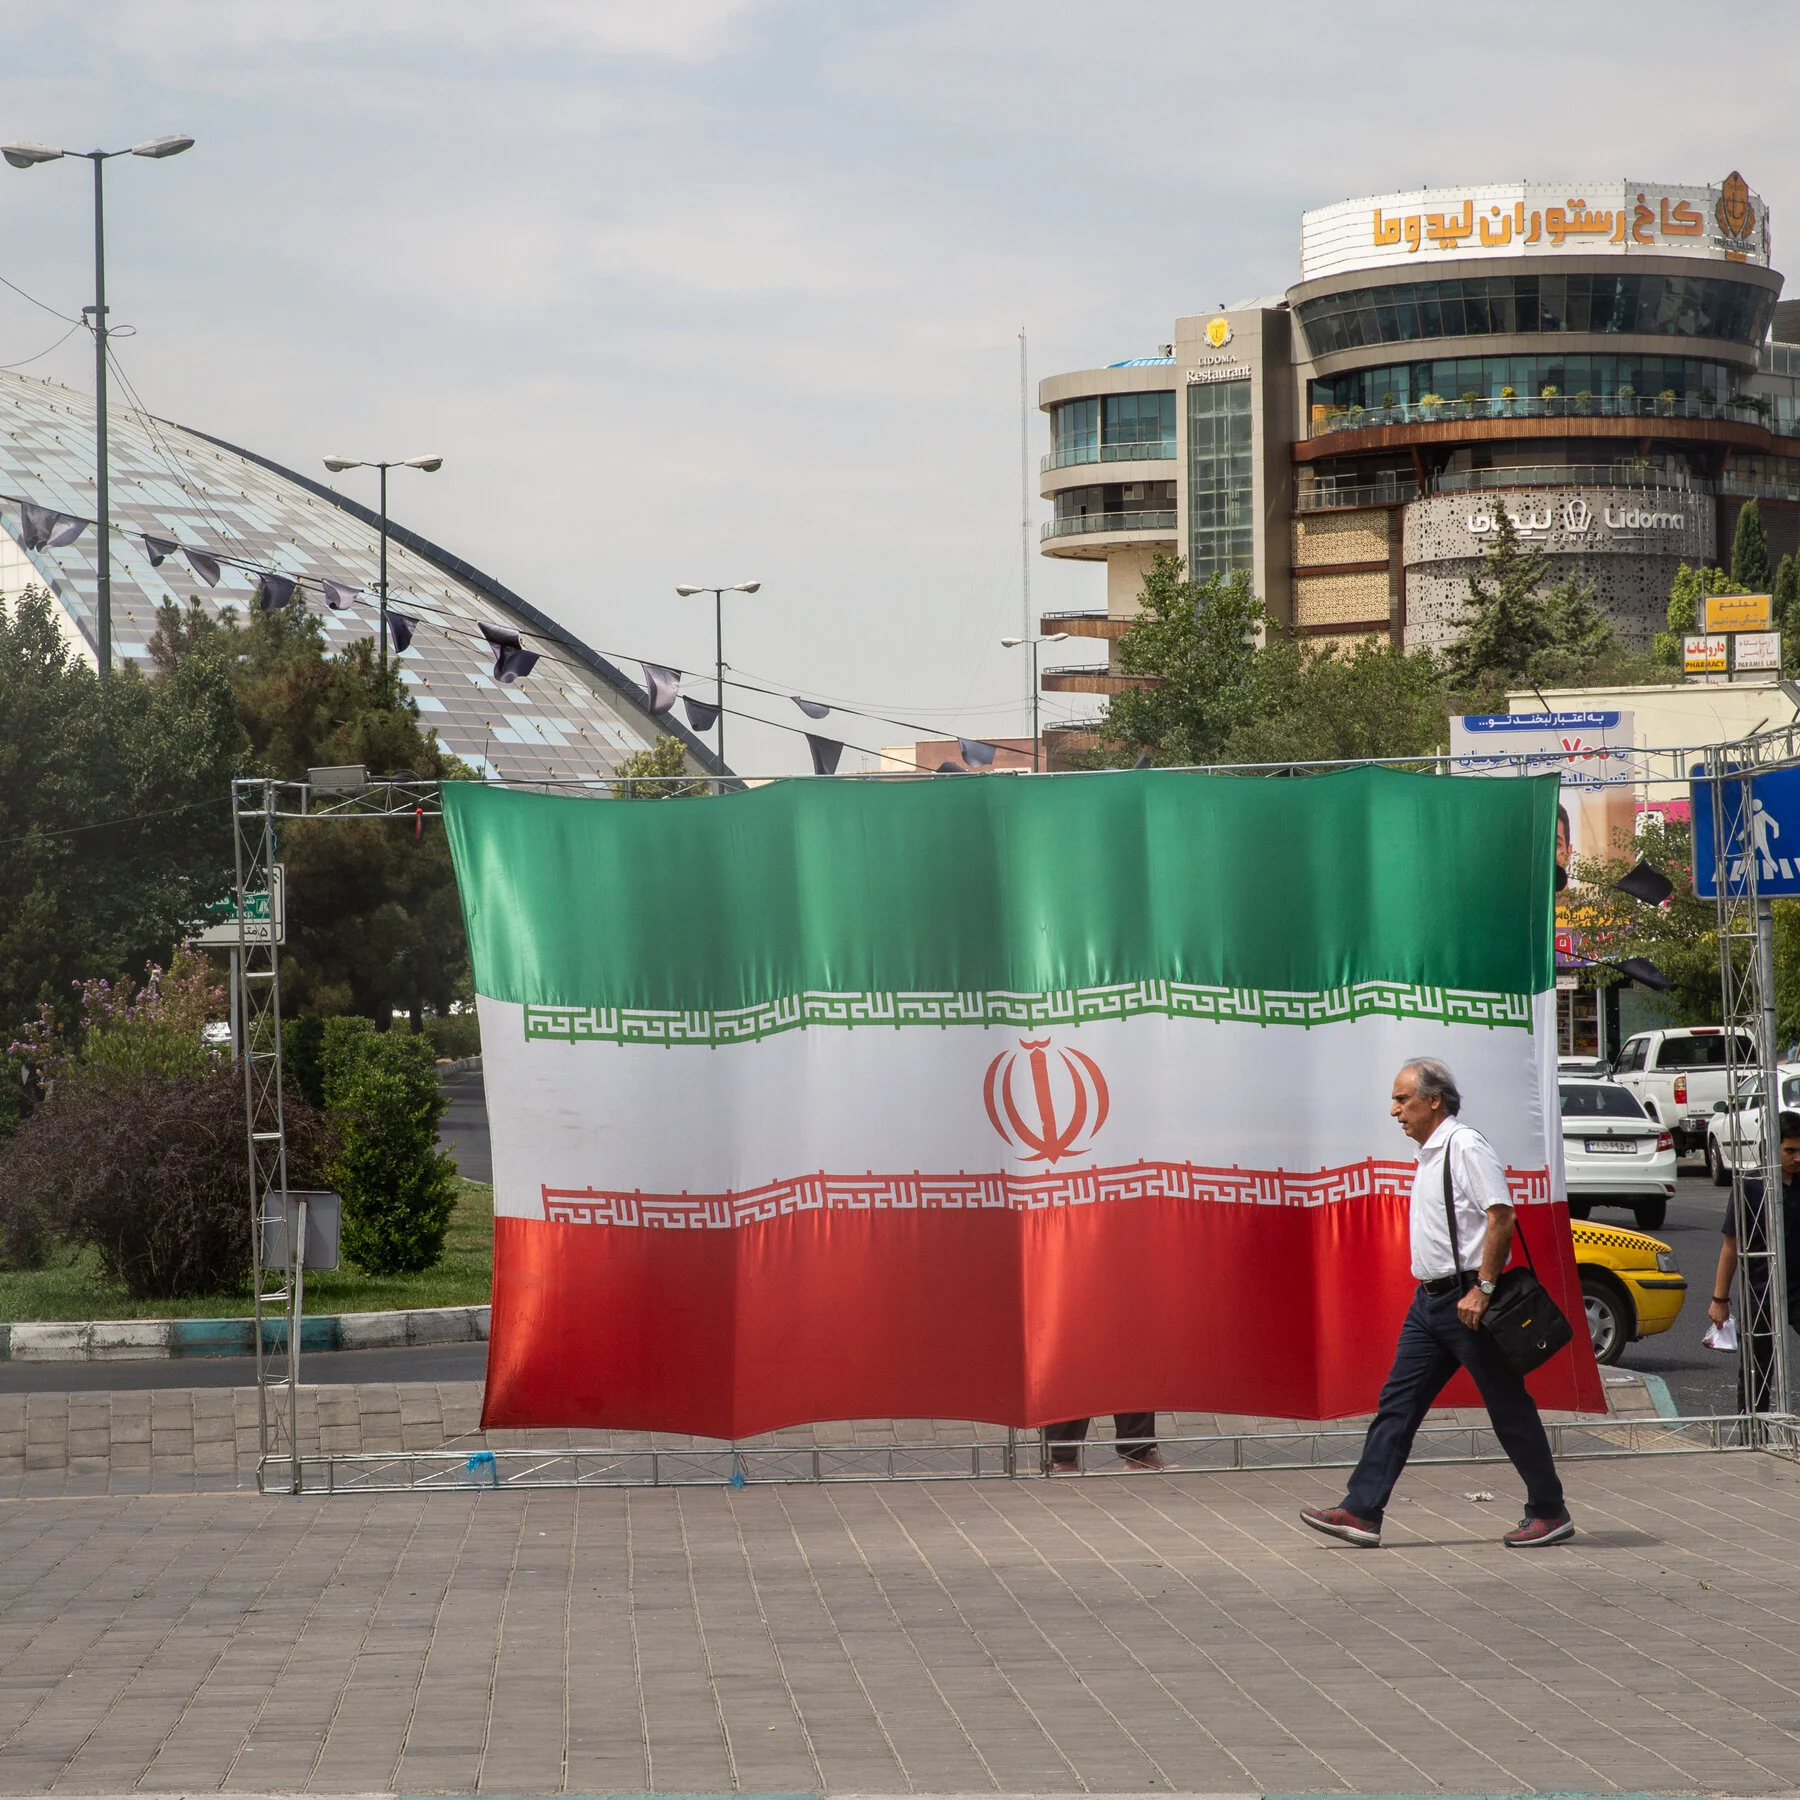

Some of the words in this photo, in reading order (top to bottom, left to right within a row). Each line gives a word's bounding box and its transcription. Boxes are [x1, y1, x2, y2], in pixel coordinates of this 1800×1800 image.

[1373, 199, 1473, 253] لیدوما
[1479, 198, 1626, 245] رستوران
[1633, 193, 1704, 245] کاخ
[1198, 354, 1238, 367] LIDOMA
[1186, 365, 1251, 382] Restaurant
[1604, 507, 1685, 530] Lidoma
[1551, 533, 1604, 543] CENTER
[1766, 659, 1777, 667] LAB
[1513, 713, 1553, 725] لبخند
[1553, 711, 1586, 726] اعتبار
[1587, 714, 1605, 724] به
